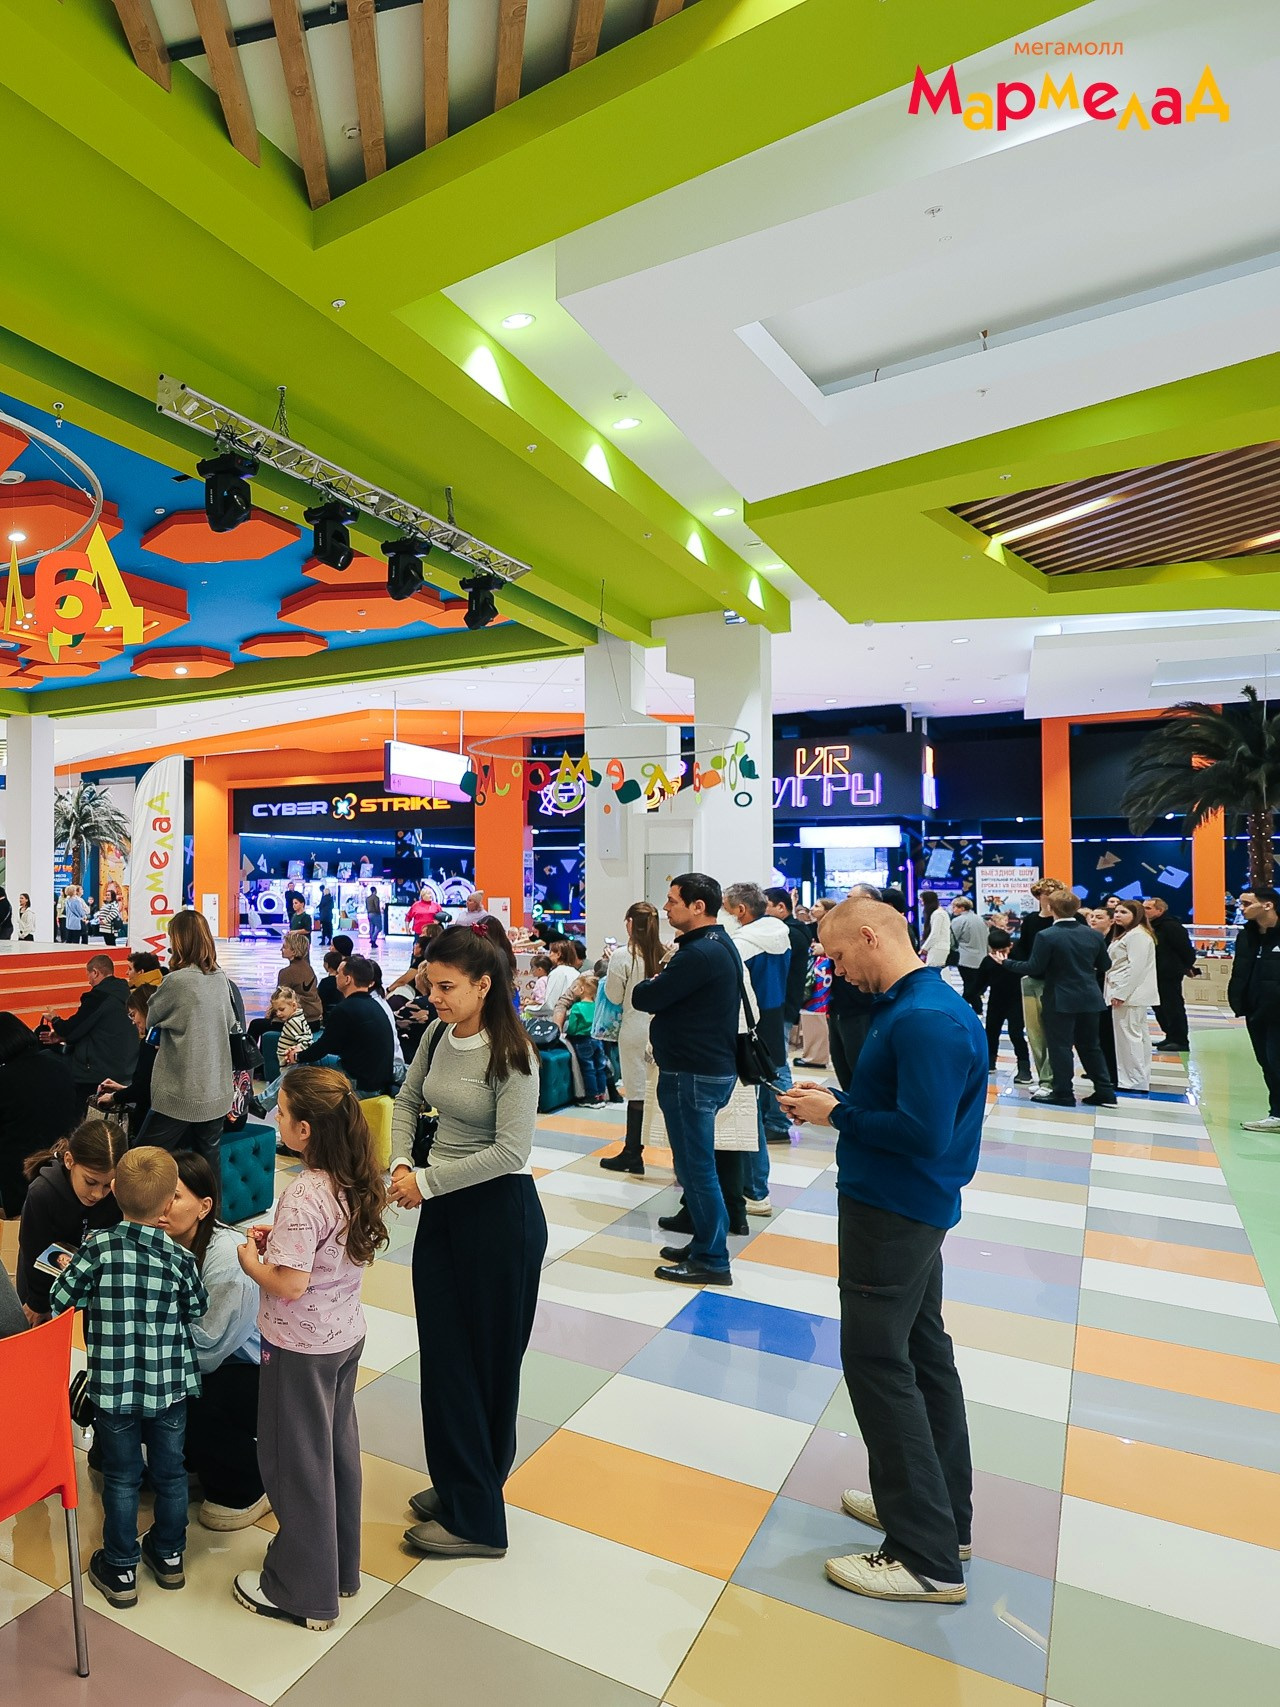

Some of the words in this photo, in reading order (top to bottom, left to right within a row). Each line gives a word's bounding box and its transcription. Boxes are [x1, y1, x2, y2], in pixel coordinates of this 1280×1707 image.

[794, 744, 850, 777] VR
[252, 801, 328, 817] CYBER
[359, 796, 452, 813] STRIKE
